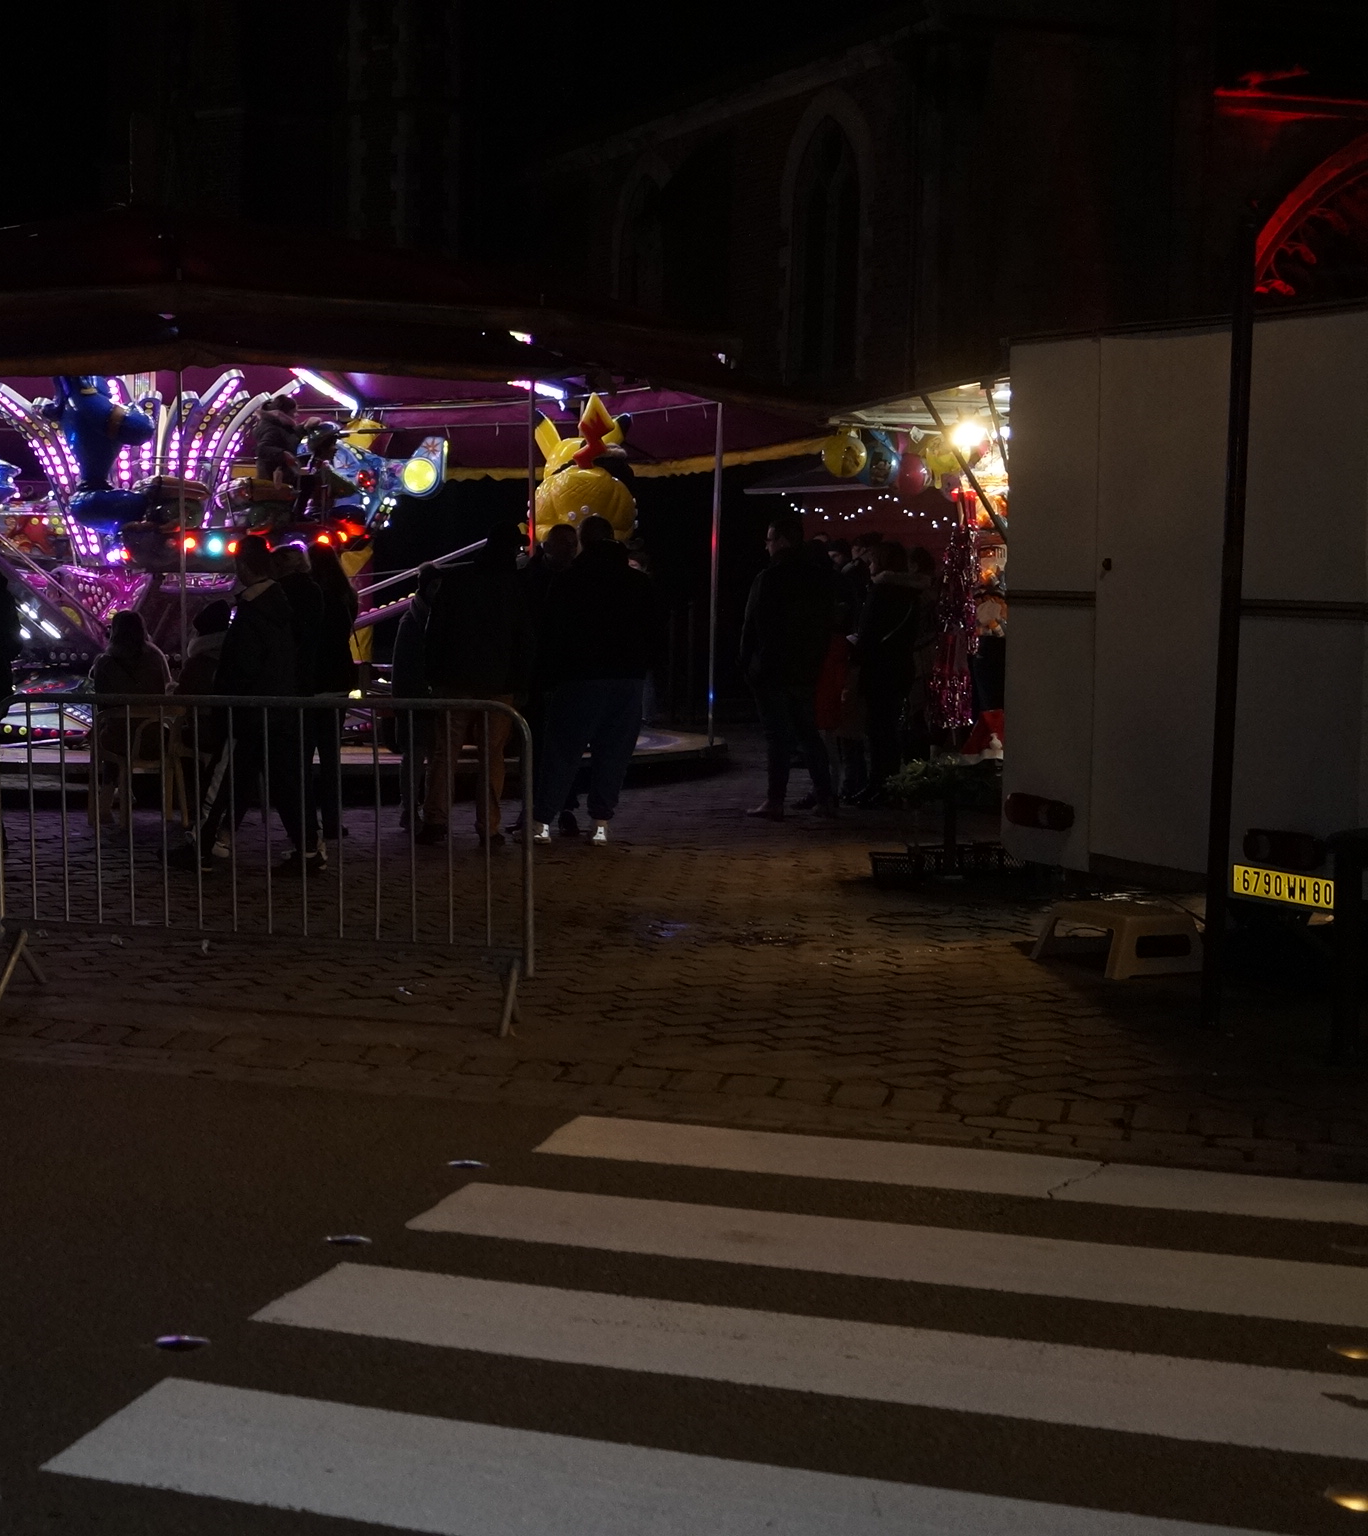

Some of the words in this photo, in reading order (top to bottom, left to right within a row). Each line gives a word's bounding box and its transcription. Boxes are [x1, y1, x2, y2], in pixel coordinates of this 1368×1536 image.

[1242, 869, 1282, 897] 6790
[1287, 876, 1307, 902] WH
[1312, 881, 1333, 906] 80
